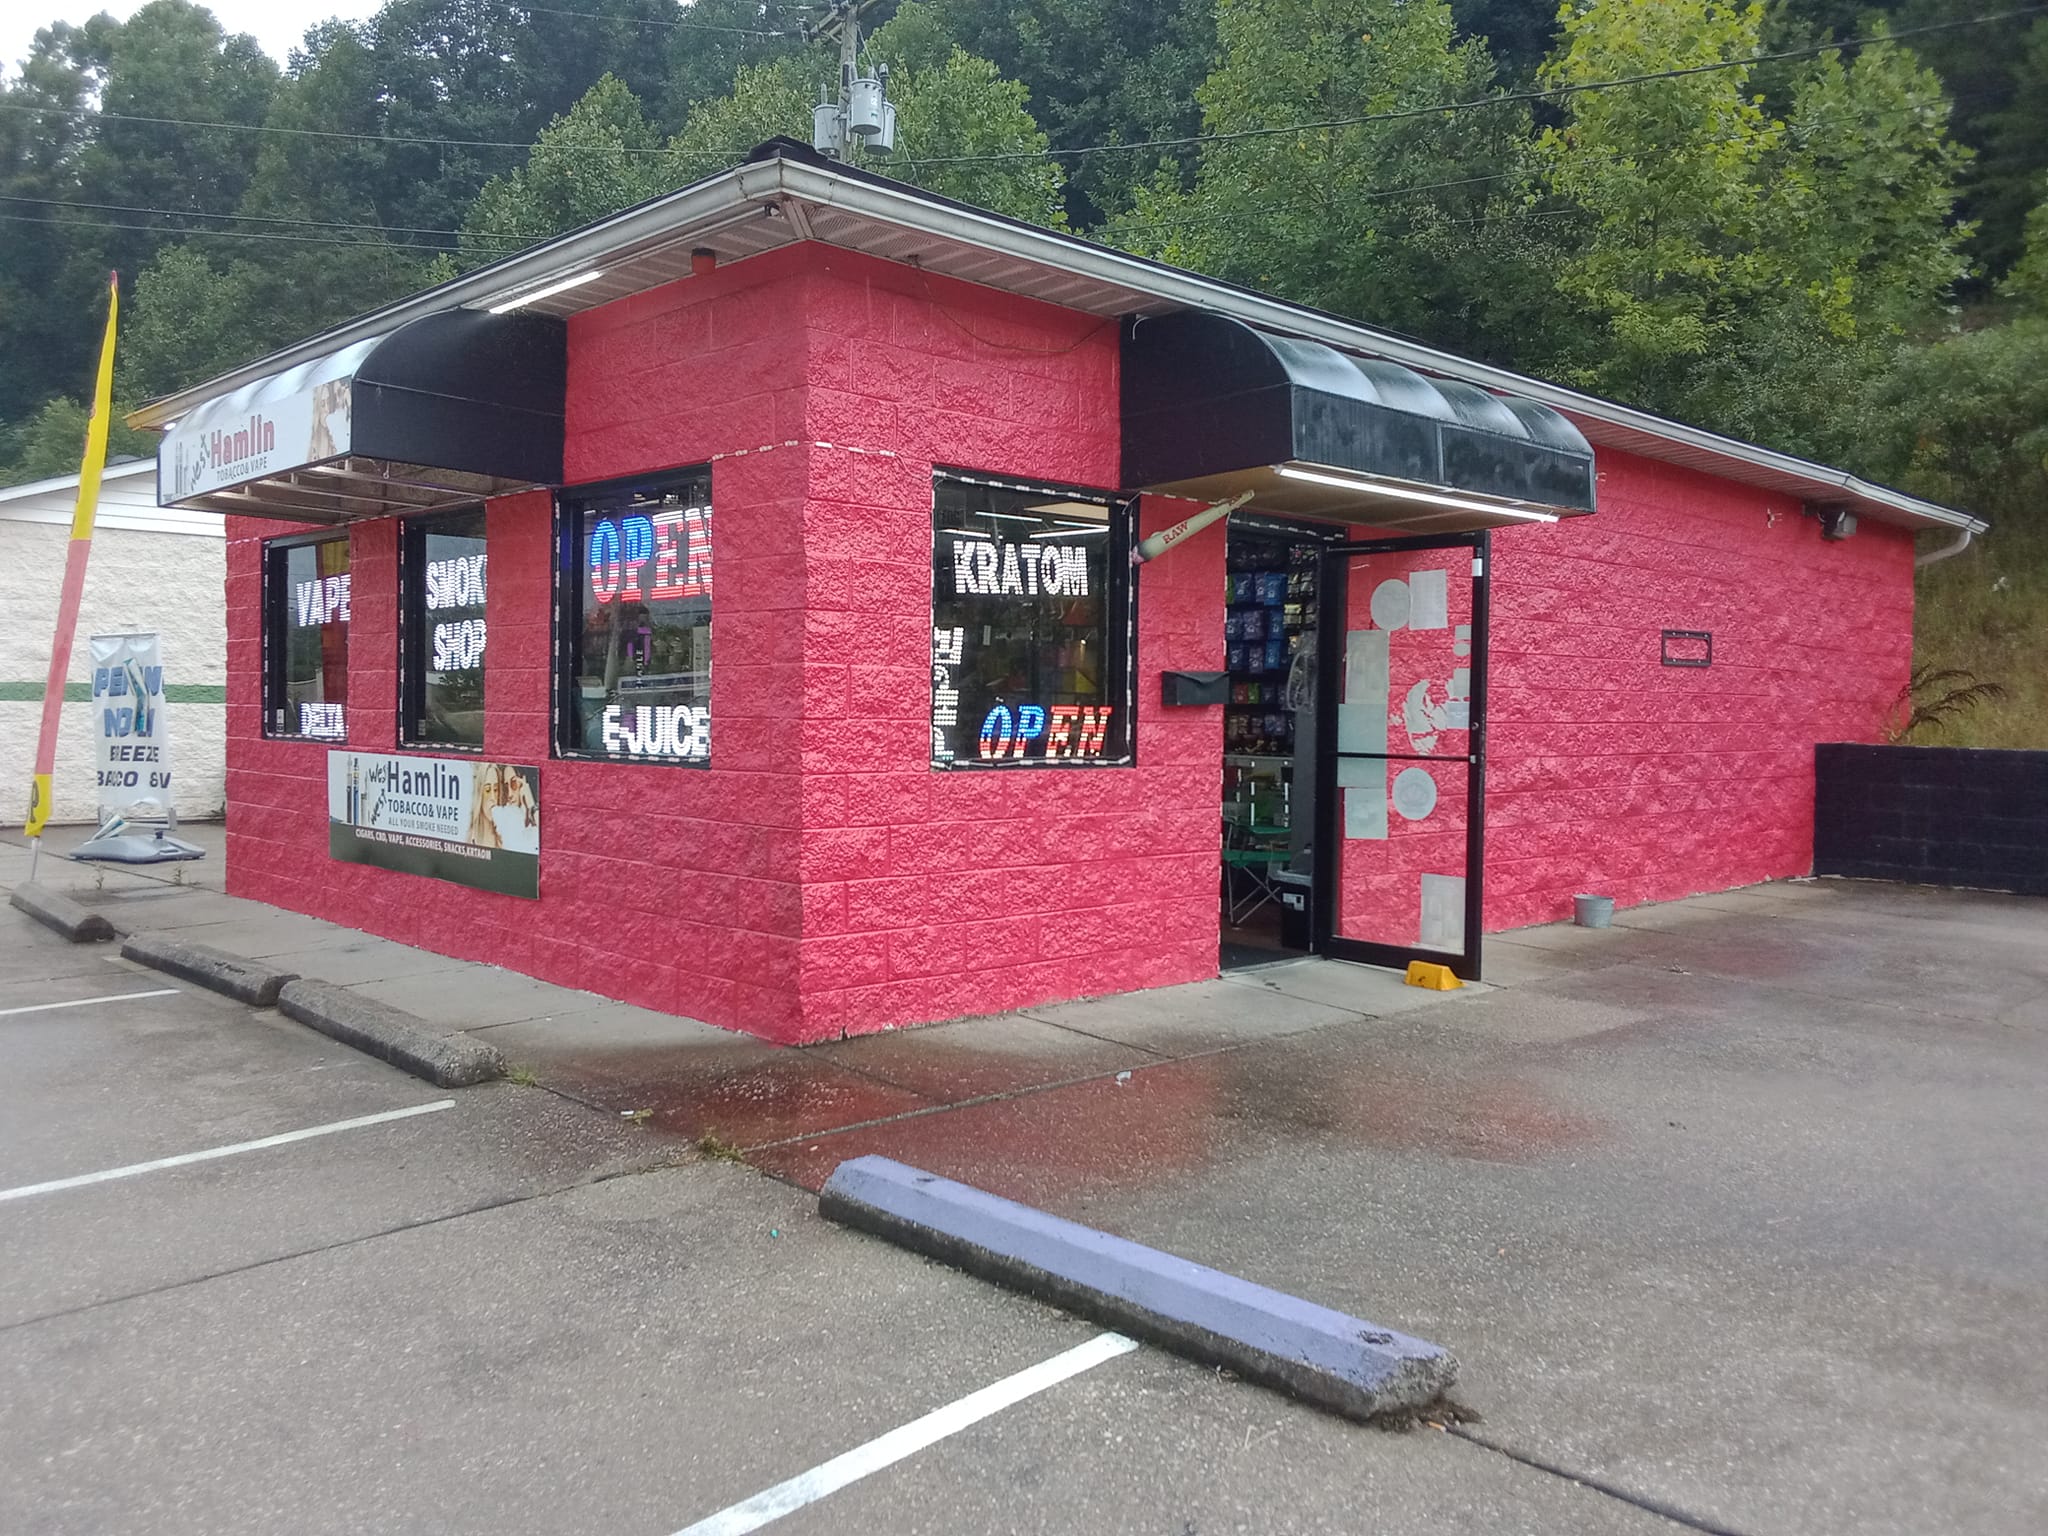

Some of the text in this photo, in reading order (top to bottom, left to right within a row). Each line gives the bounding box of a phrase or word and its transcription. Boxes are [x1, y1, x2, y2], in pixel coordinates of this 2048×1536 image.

[211, 414, 274, 469] Hamlin
[251, 456, 267, 473] VAPE
[590, 506, 713, 604] OPEN
[1163, 521, 1188, 544] RAW
[425, 554, 488, 609] SMOK
[953, 540, 1089, 596] KRATOM
[296, 574, 351, 627] VAPE
[433, 618, 488, 670] SHOP
[300, 703, 345, 736] DELTA
[602, 704, 712, 756] E-JUICE
[978, 704, 1112, 759] OPEN
[387, 760, 460, 800] Hamlin
[388, 799, 459, 821] TOBACCO& VAPE
[388, 817, 399, 827] ALL
[400, 818, 415, 829] YOUR
[416, 820, 436, 831] SMOKE
[388, 833, 404, 846] VAPE,
[405, 835, 443, 852] ACCESSORIES,
